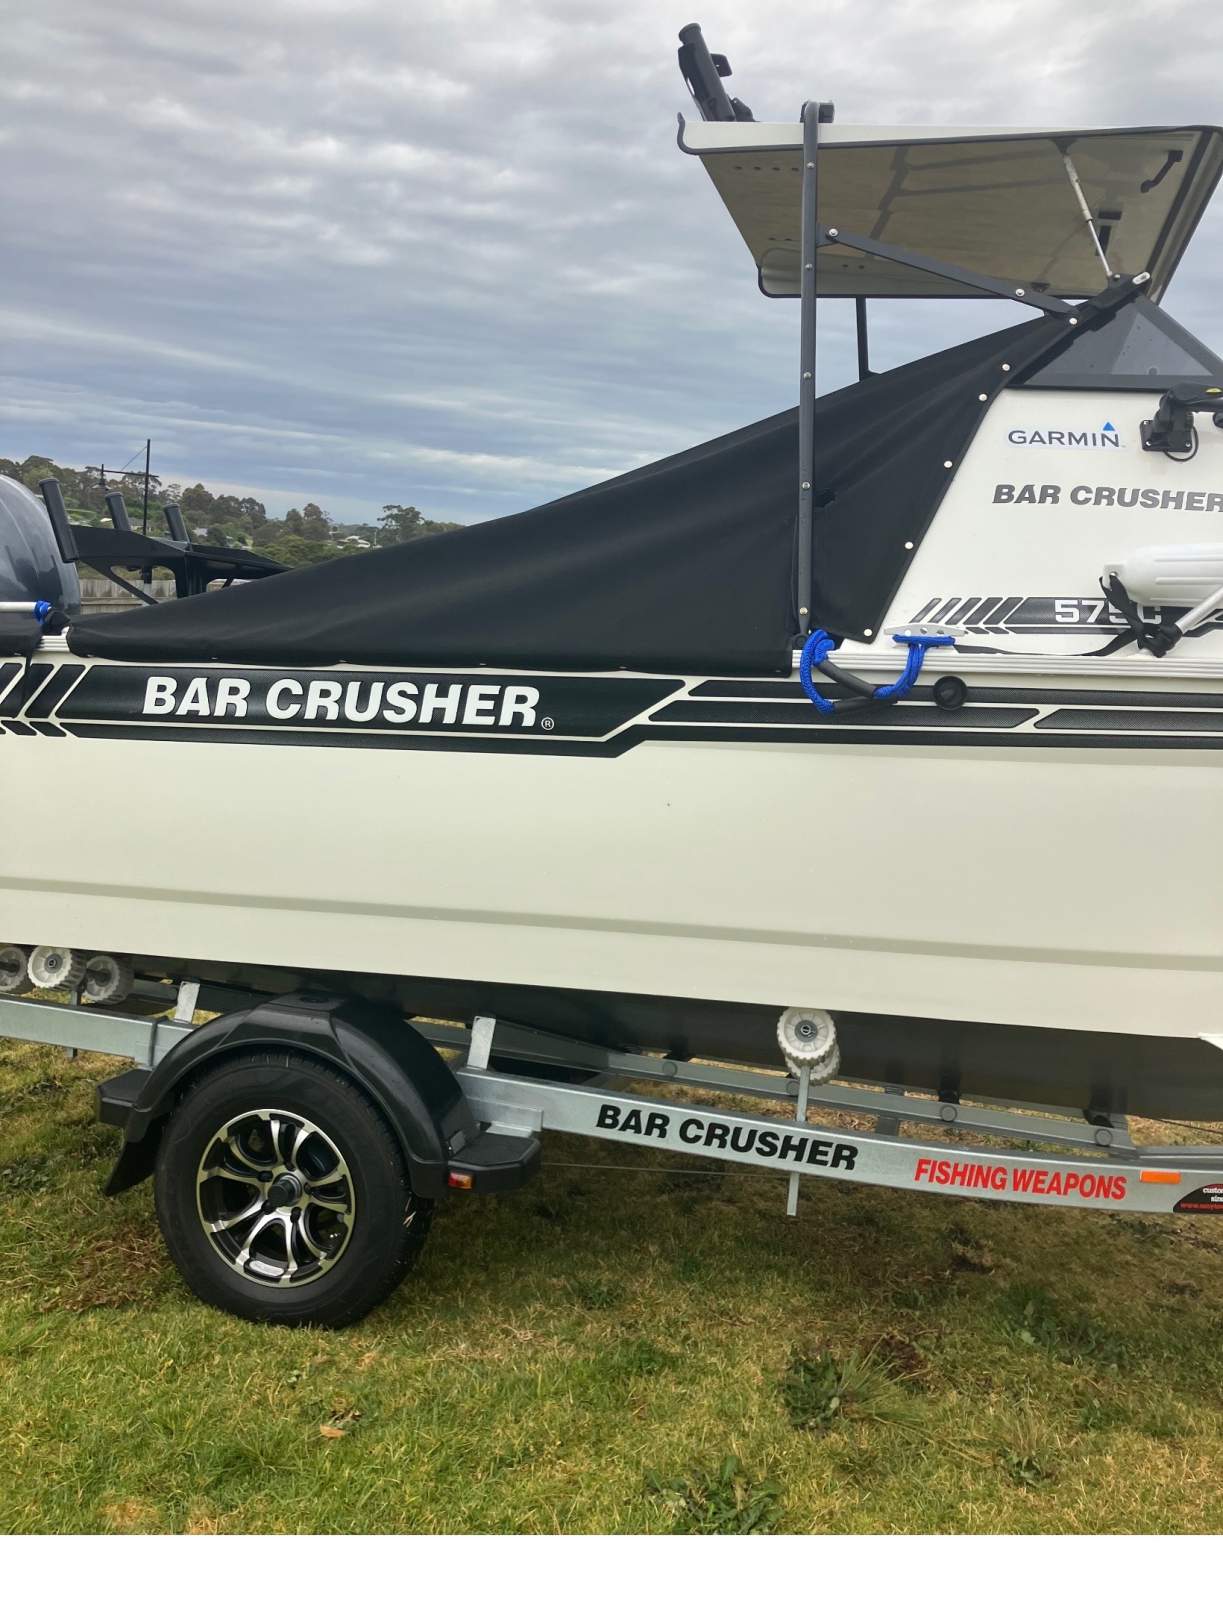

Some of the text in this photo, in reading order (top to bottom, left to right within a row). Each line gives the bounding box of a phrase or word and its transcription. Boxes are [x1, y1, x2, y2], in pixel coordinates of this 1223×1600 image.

[1008, 430, 1120, 448] GARMIN
[992, 484, 1223, 513] BAR CRUSHER
[142, 676, 251, 718] BAR
[265, 678, 540, 727] CRUSHER
[596, 1104, 859, 1171] BAR CRUSHER
[914, 1158, 1128, 1200] FISHING WEAPONS
